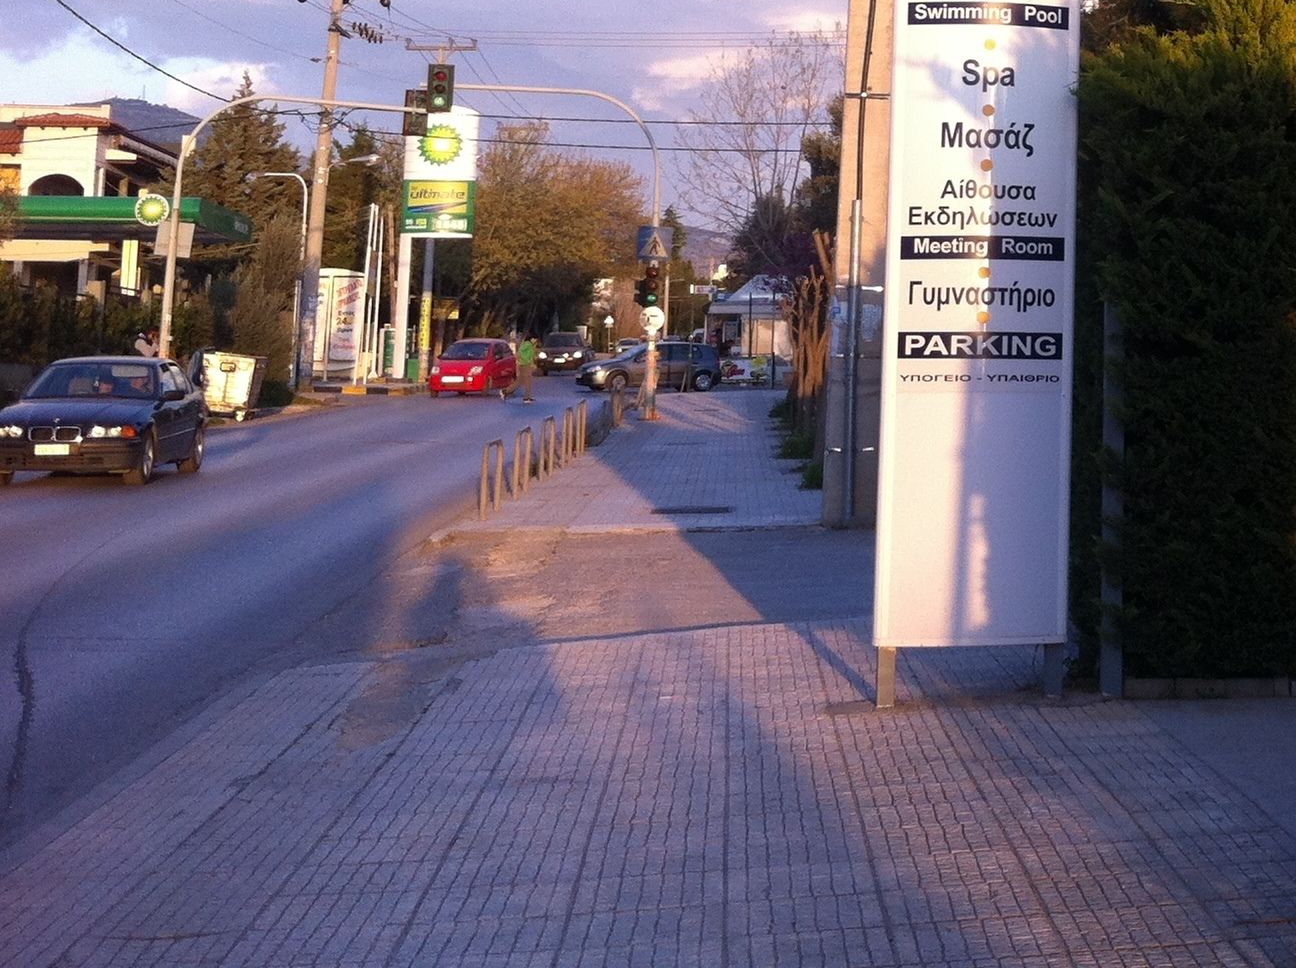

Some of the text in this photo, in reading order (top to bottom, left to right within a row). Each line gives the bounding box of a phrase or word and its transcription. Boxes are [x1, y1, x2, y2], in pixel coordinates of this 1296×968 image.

[914, 3, 1062, 24] Swimming Pool
[962, 59, 1016, 93] Spa
[940, 121, 1036, 158] Μασάζ
[940, 179, 1037, 201] Αίθουσα
[908, 206, 1059, 231] Εκδηλώσεων
[913, 237, 1054, 258] Meeting Room
[908, 280, 1056, 313] Γυμναστήριο
[904, 334, 1057, 357] PARKING
[900, 374, 972, 383] ΥΠΟΓΕΙΟ
[986, 374, 1060, 383] ΥΠΑΙΘΡΙΟ
